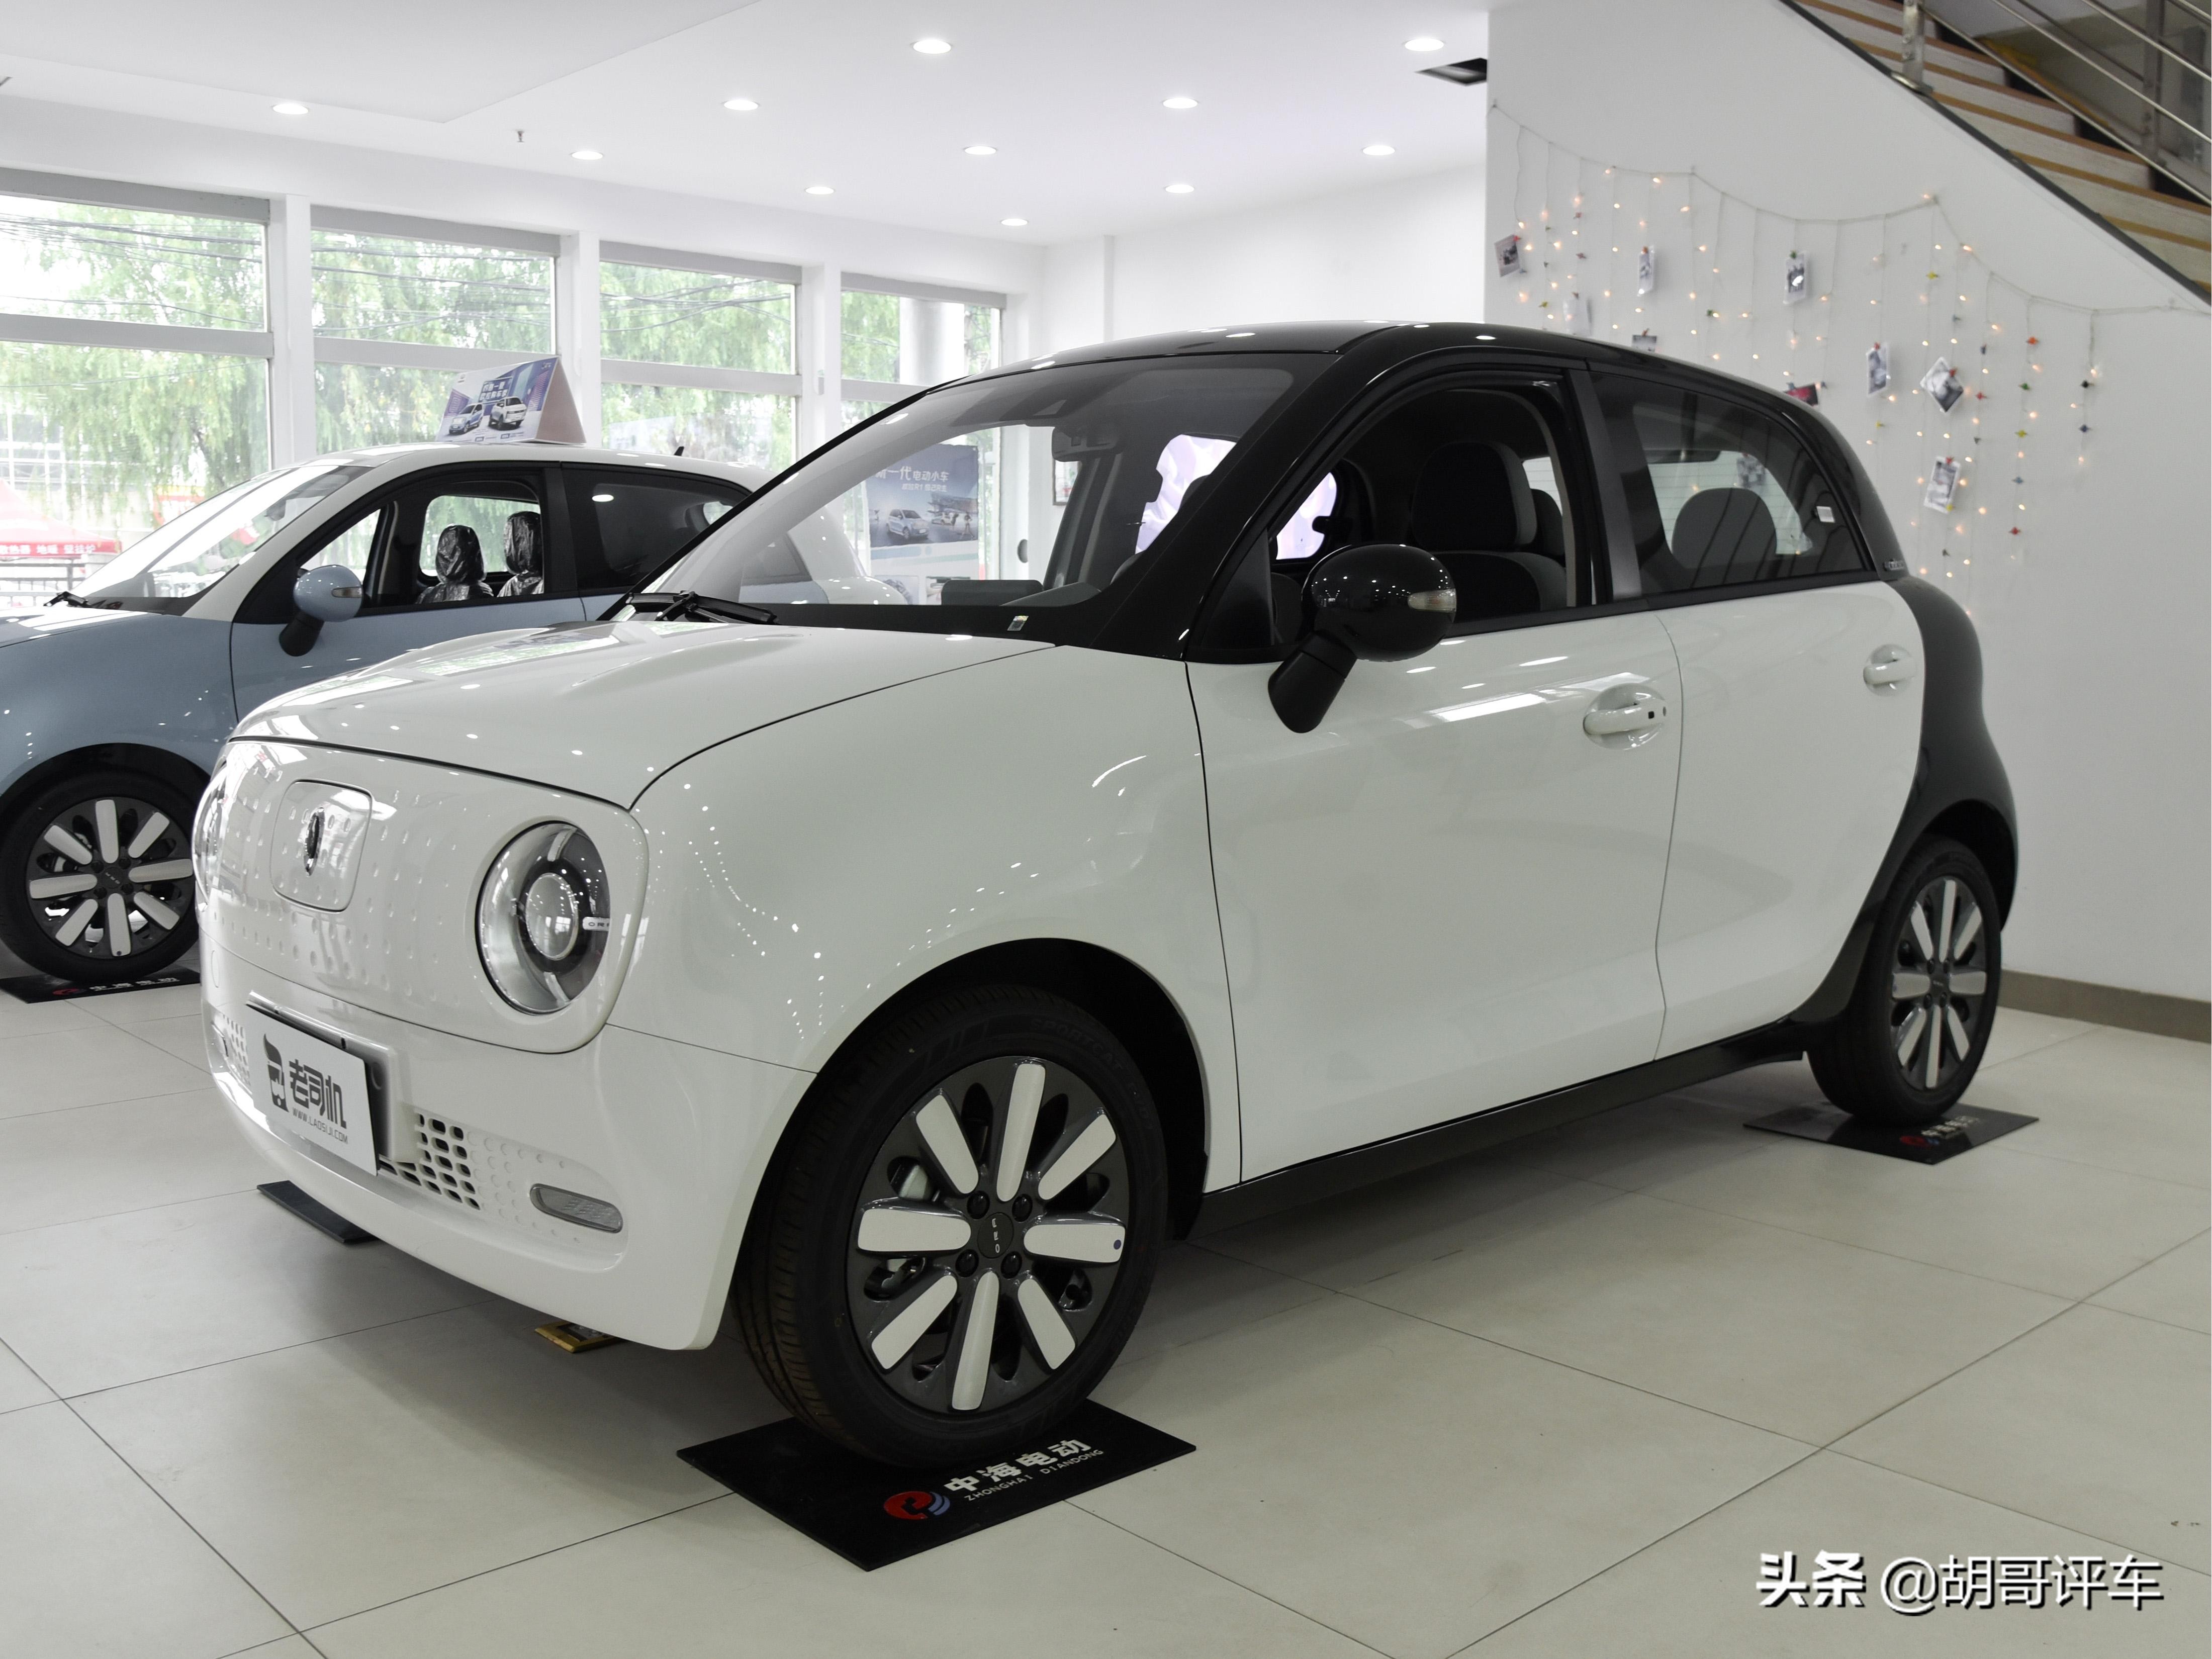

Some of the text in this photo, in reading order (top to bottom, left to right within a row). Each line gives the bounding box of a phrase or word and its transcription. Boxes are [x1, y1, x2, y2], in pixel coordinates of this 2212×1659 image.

[289, 1059, 347, 1129] 老司机
[944, 1439, 1091, 1492] 中海电动
[964, 1449, 1104, 1501] ZHONGHAI DIANDONG
